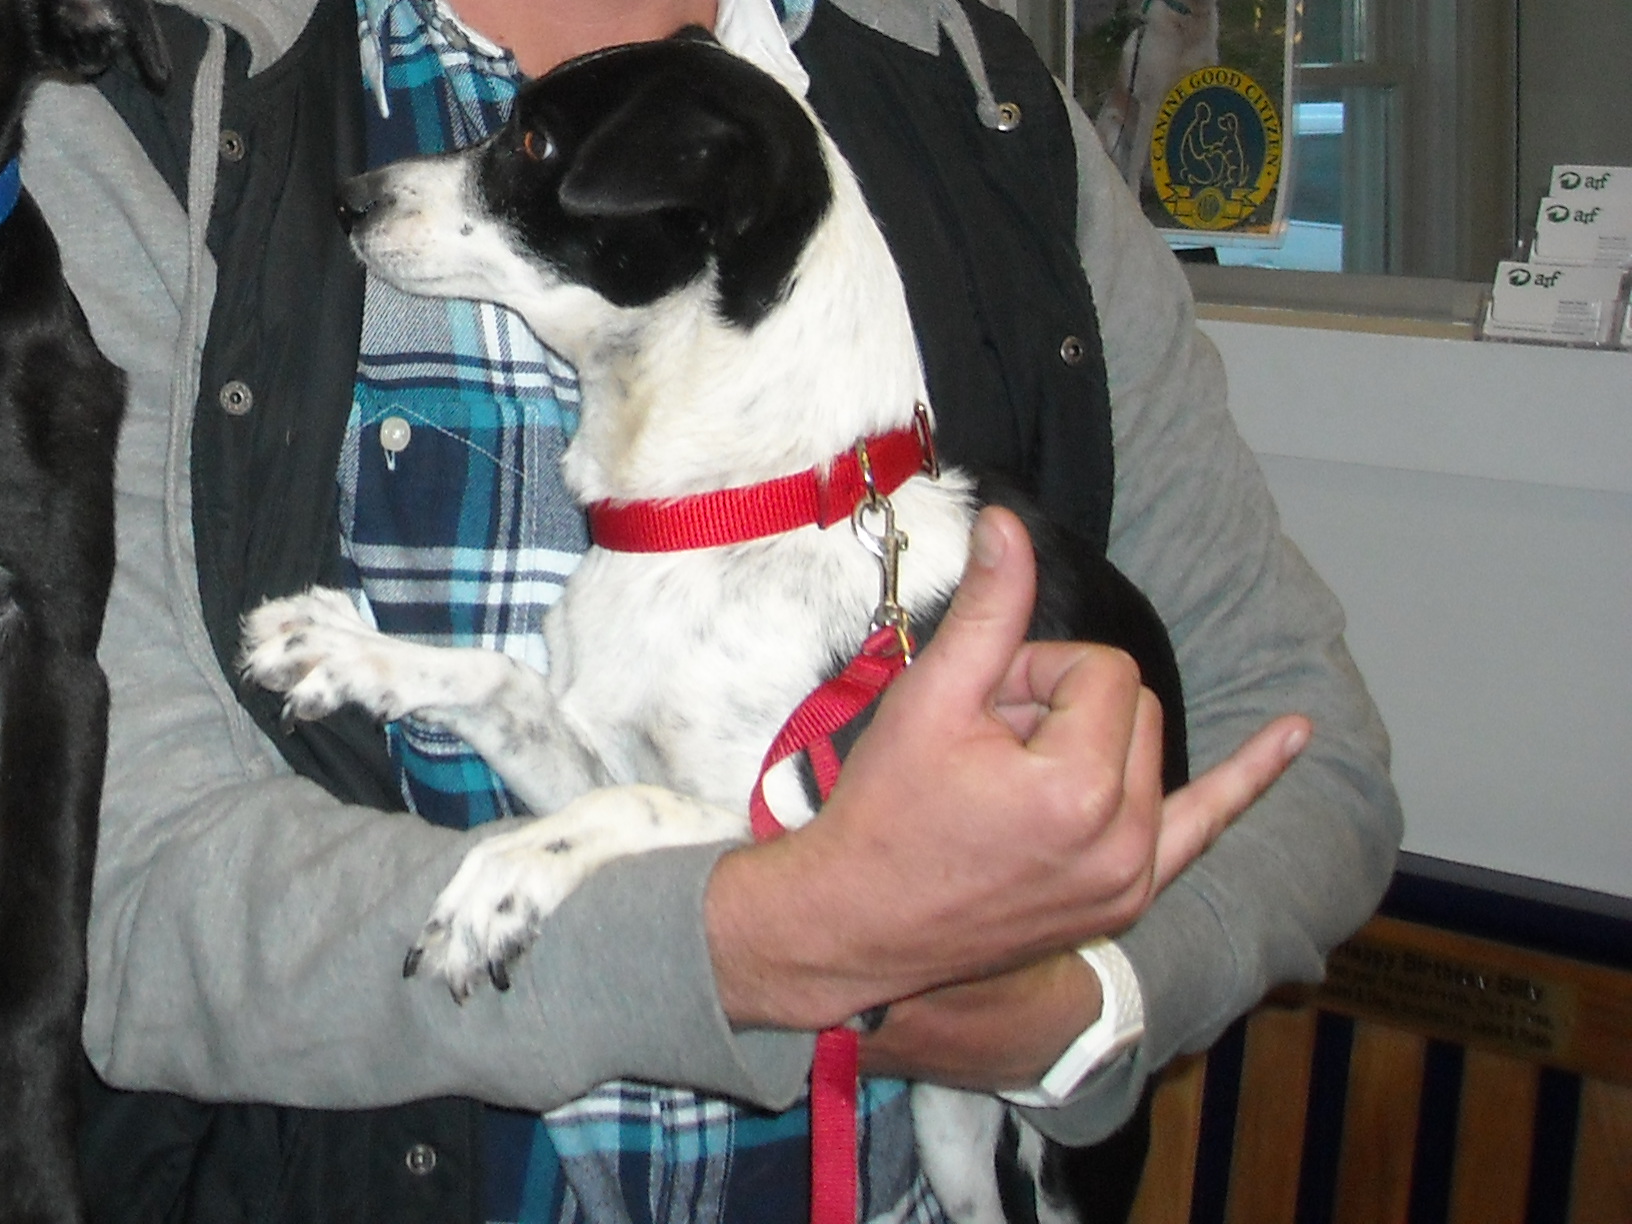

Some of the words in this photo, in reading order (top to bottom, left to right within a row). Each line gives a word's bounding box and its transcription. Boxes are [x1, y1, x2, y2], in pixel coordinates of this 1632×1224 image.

[1153, 88, 1187, 162] CANINE
[1189, 70, 1241, 89] GOOD
[1245, 84, 1280, 167] CITIZEN
[1584, 173, 1611, 191] arf
[1573, 207, 1600, 224] arf
[1534, 270, 1562, 288] arf
